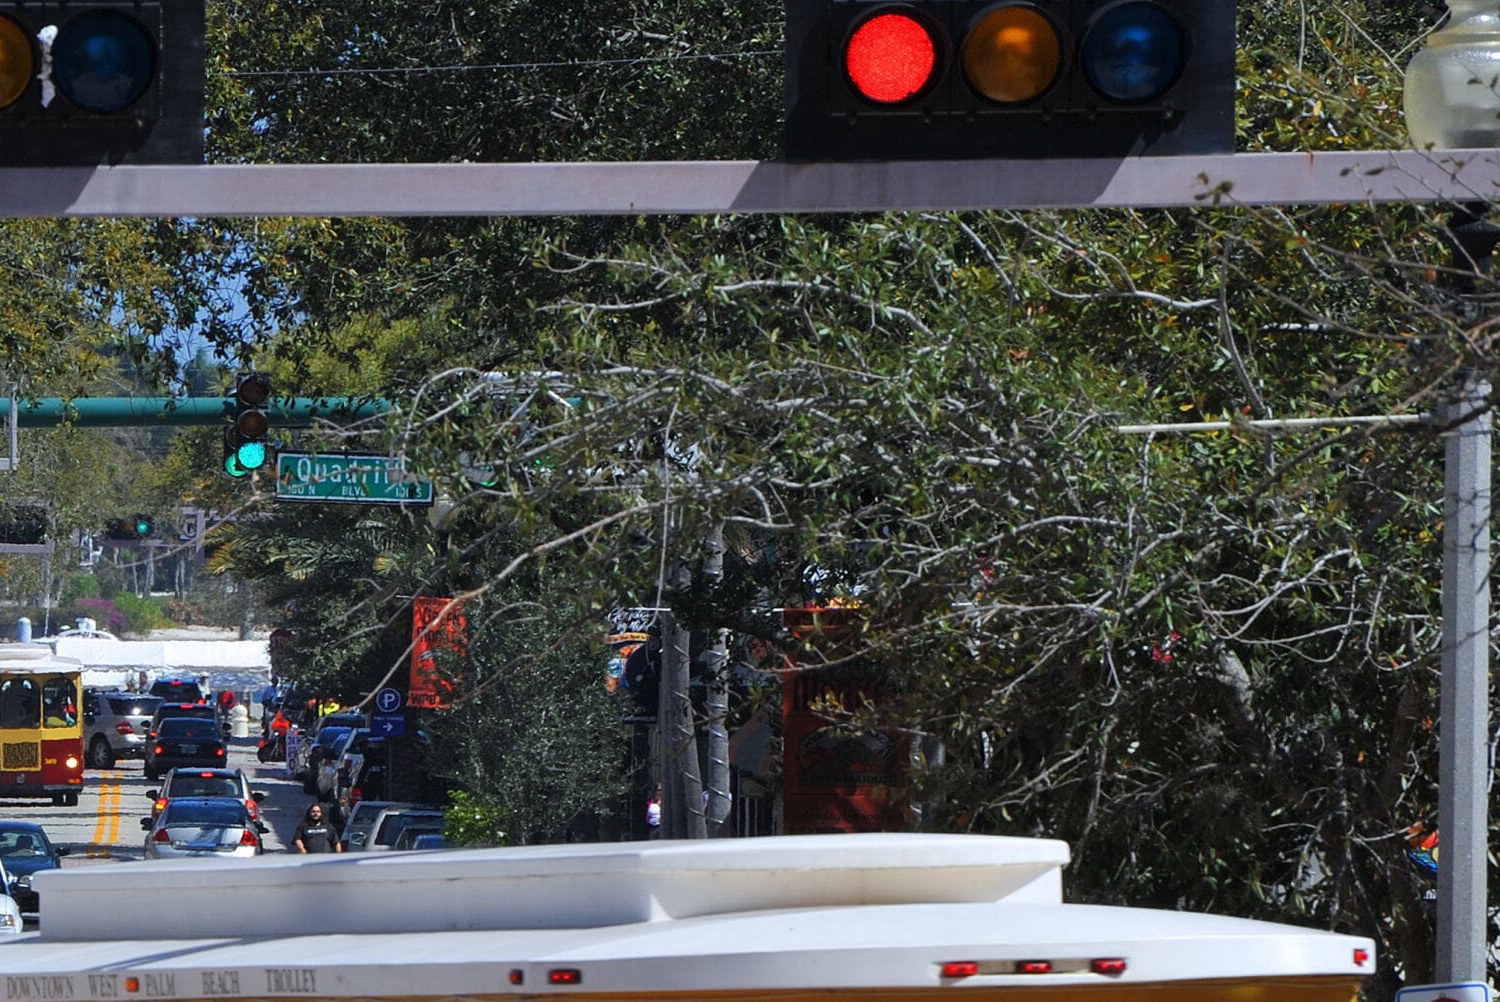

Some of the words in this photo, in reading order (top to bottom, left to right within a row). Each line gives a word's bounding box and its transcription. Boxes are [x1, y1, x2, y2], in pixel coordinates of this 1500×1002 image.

[6, 975, 74, 999] DOWNTOWN
[88, 974, 118, 997] WEST
[145, 973, 176, 996] PALM
[202, 971, 240, 995] BEACH
[265, 968, 317, 993] TROLLEY
